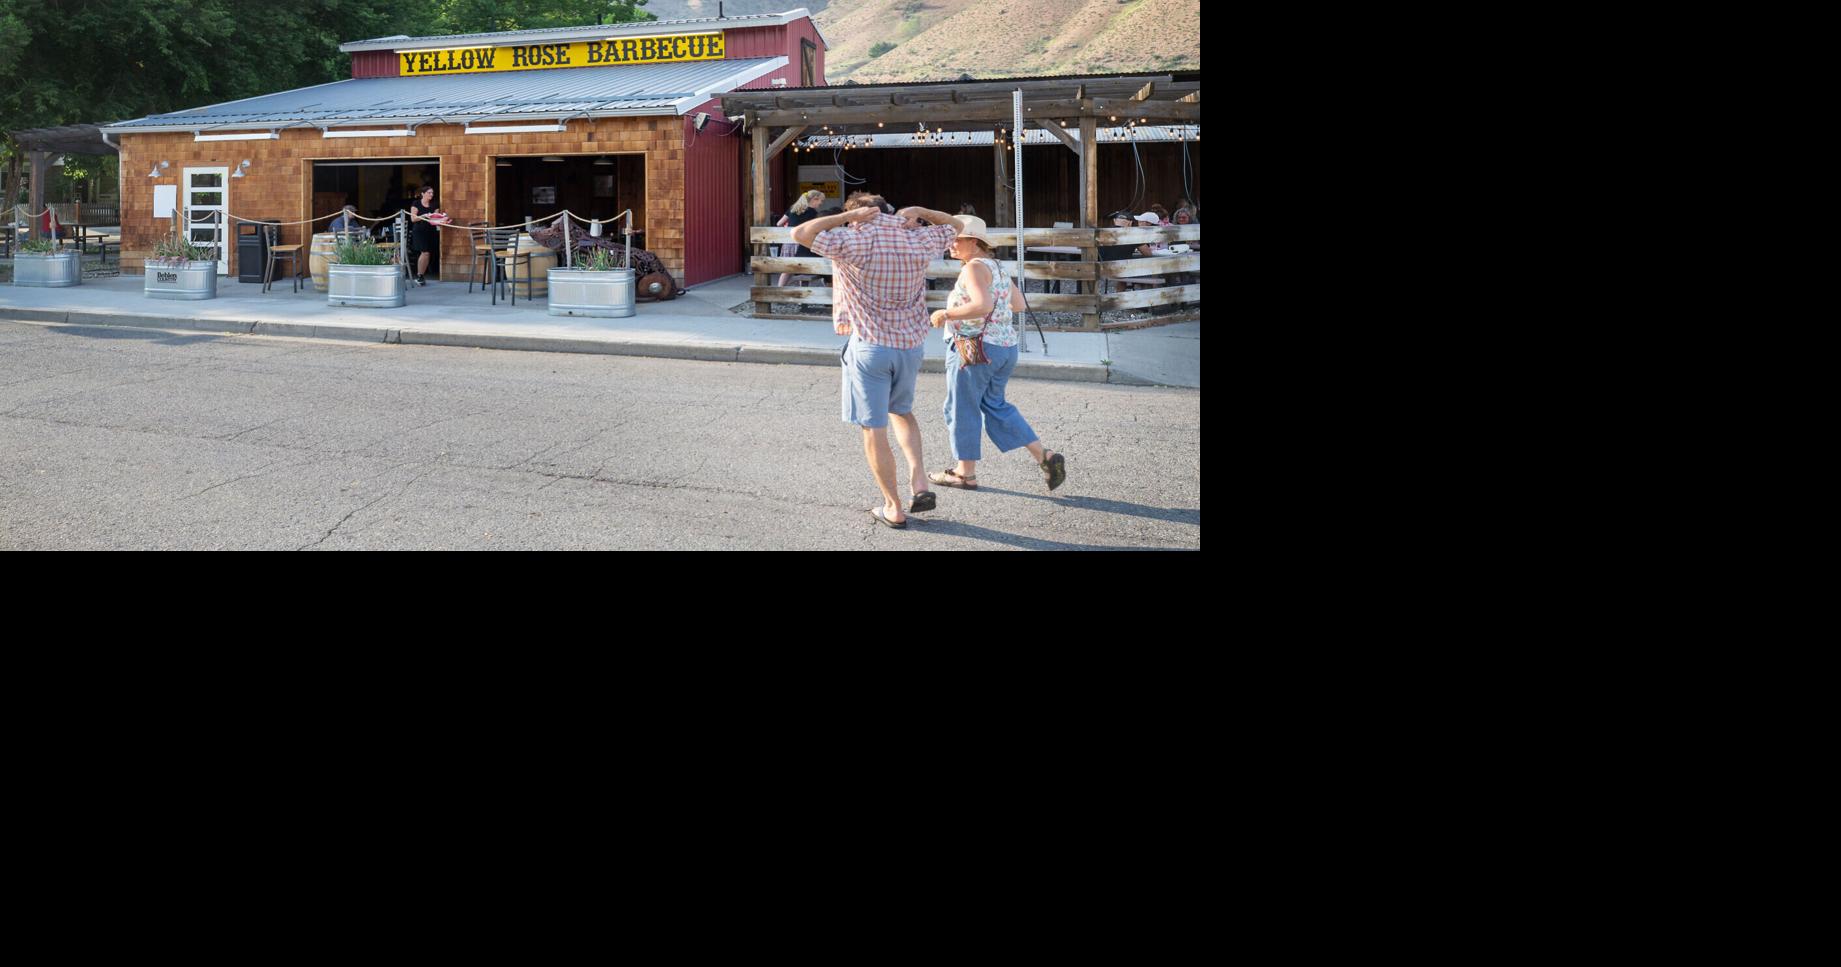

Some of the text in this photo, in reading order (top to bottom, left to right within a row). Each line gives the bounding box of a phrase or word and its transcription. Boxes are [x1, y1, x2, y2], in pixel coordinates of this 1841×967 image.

[403, 34, 723, 73] YELLOW ROSE BARBECUE
